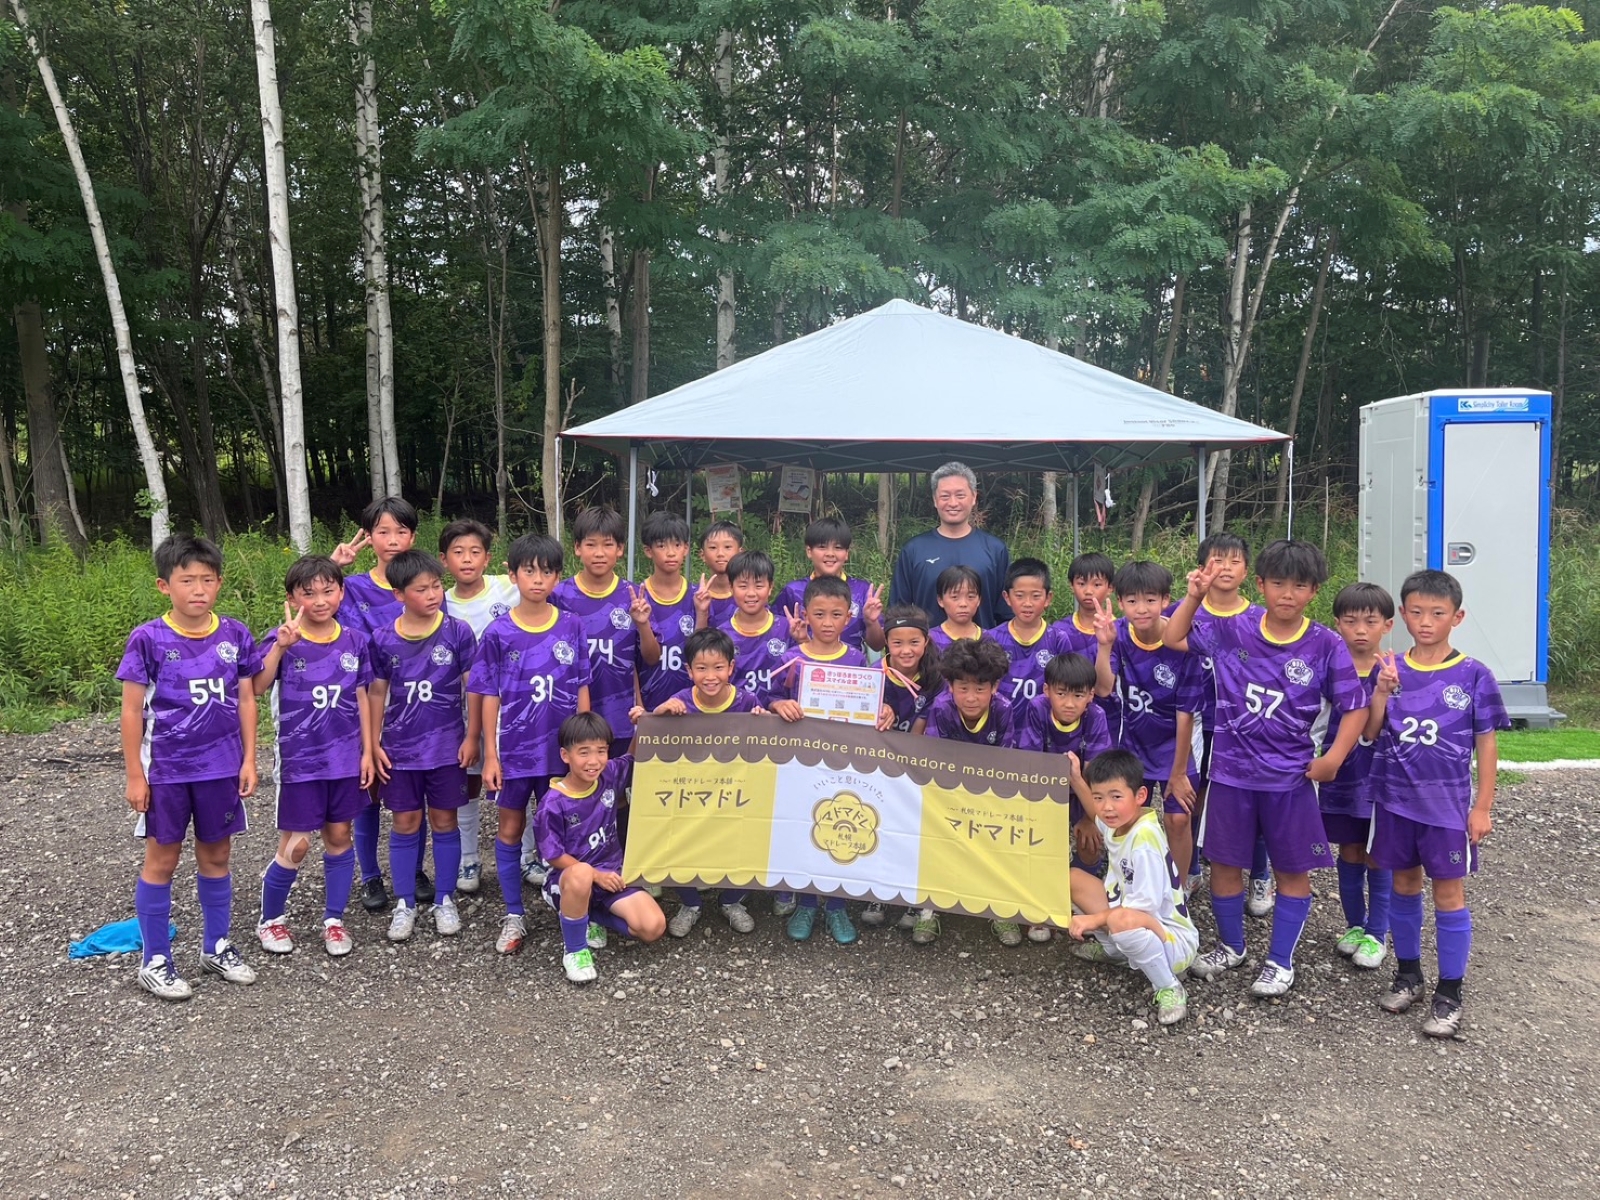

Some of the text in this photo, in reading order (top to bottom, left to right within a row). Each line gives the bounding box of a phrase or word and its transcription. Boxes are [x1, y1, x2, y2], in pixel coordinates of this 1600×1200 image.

[587, 638, 613, 665] 74
[188, 677, 225, 706] 54
[403, 680, 433, 704] 78
[529, 674, 554, 703] 31
[744, 669, 772, 692] 34
[1012, 678, 1037, 699] 70
[311, 684, 341, 708] 97
[1128, 685, 1153, 712] 52
[1245, 682, 1284, 719] 57
[1399, 716, 1438, 745] 23
[638, 734, 1068, 786] madomadore madomadore madomadore madomadore
[655, 788, 751, 809] マドマドレ
[822, 807, 868, 829] マドマドレ
[588, 826, 606, 850] 91
[838, 833, 852, 841] 札幌
[944, 816, 1045, 846] マドマドレ
